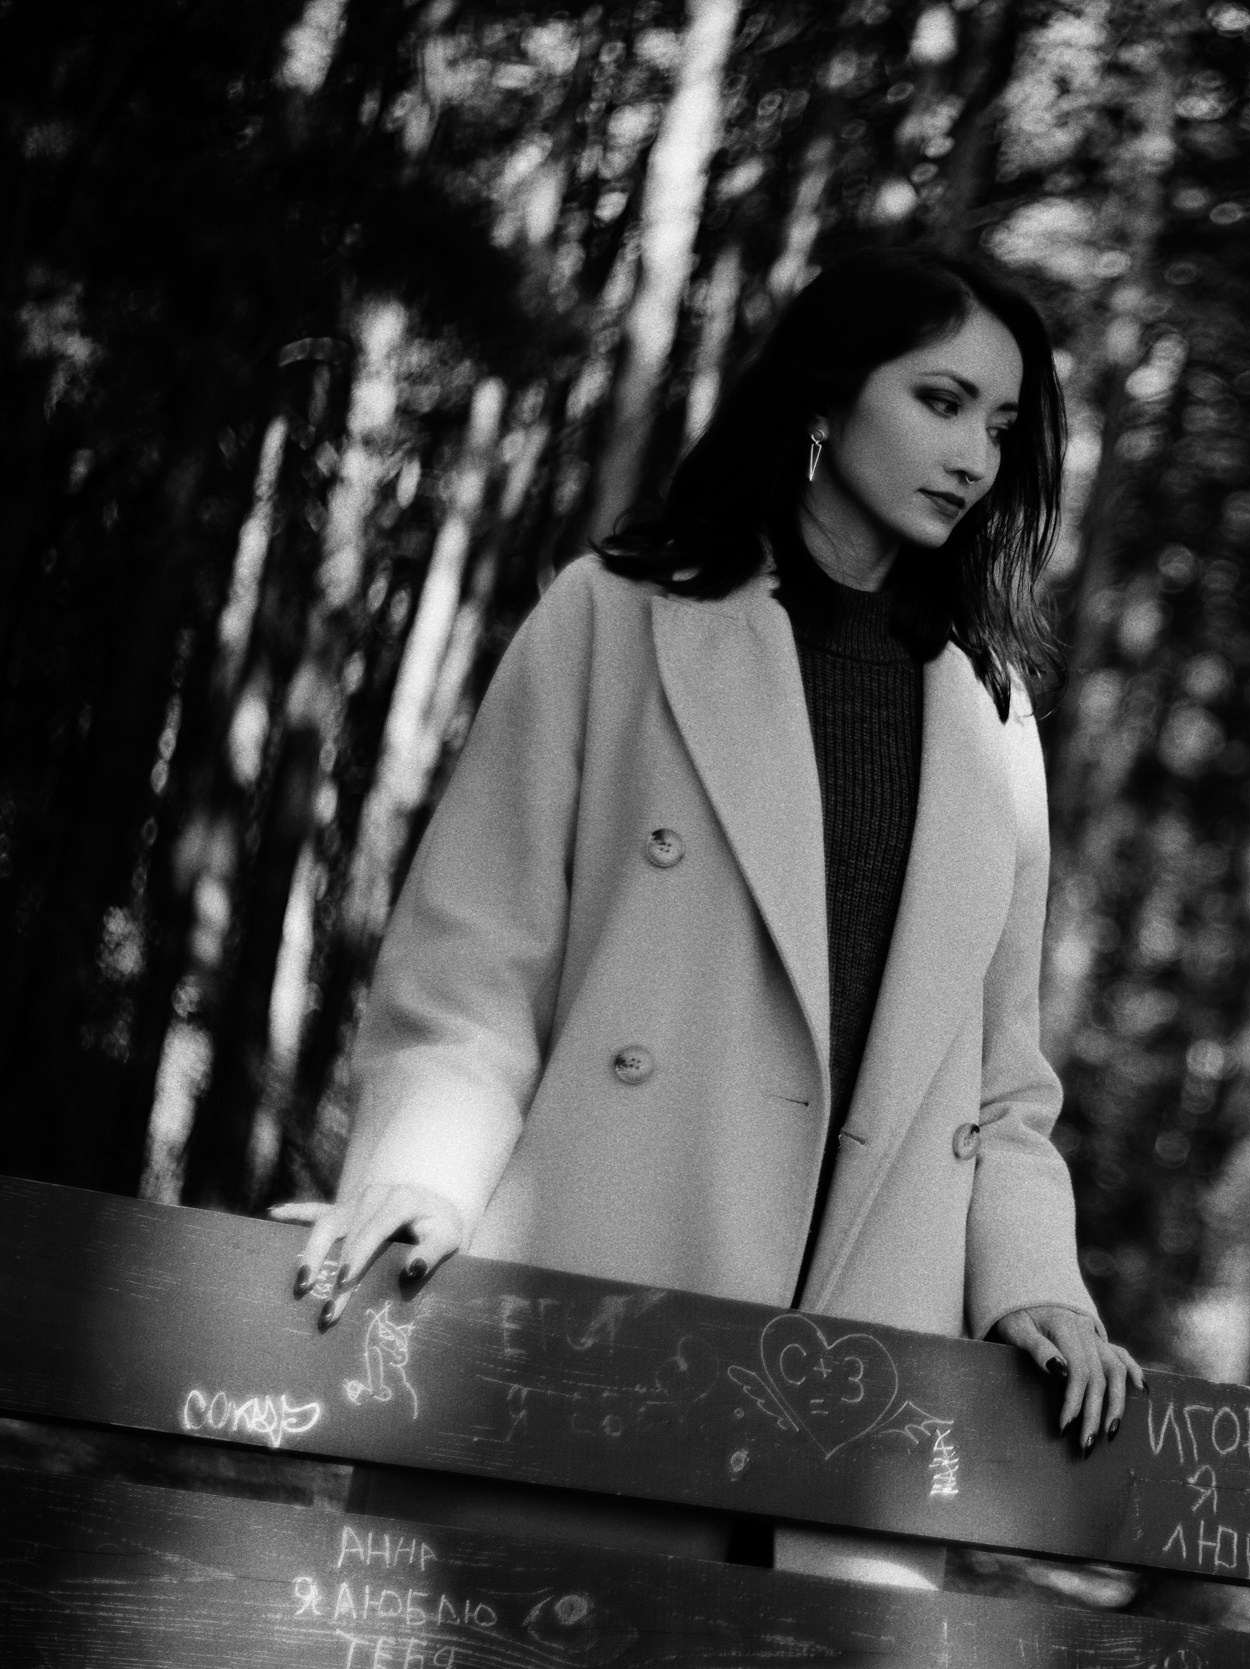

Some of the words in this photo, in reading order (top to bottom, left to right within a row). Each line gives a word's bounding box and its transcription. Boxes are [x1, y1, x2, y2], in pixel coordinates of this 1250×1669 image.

[1187, 1465, 1218, 1514] Я
[336, 1524, 438, 1572] АННА
[292, 1575, 323, 1616] Я
[333, 1581, 499, 1628] ЛЮБЛЮ
